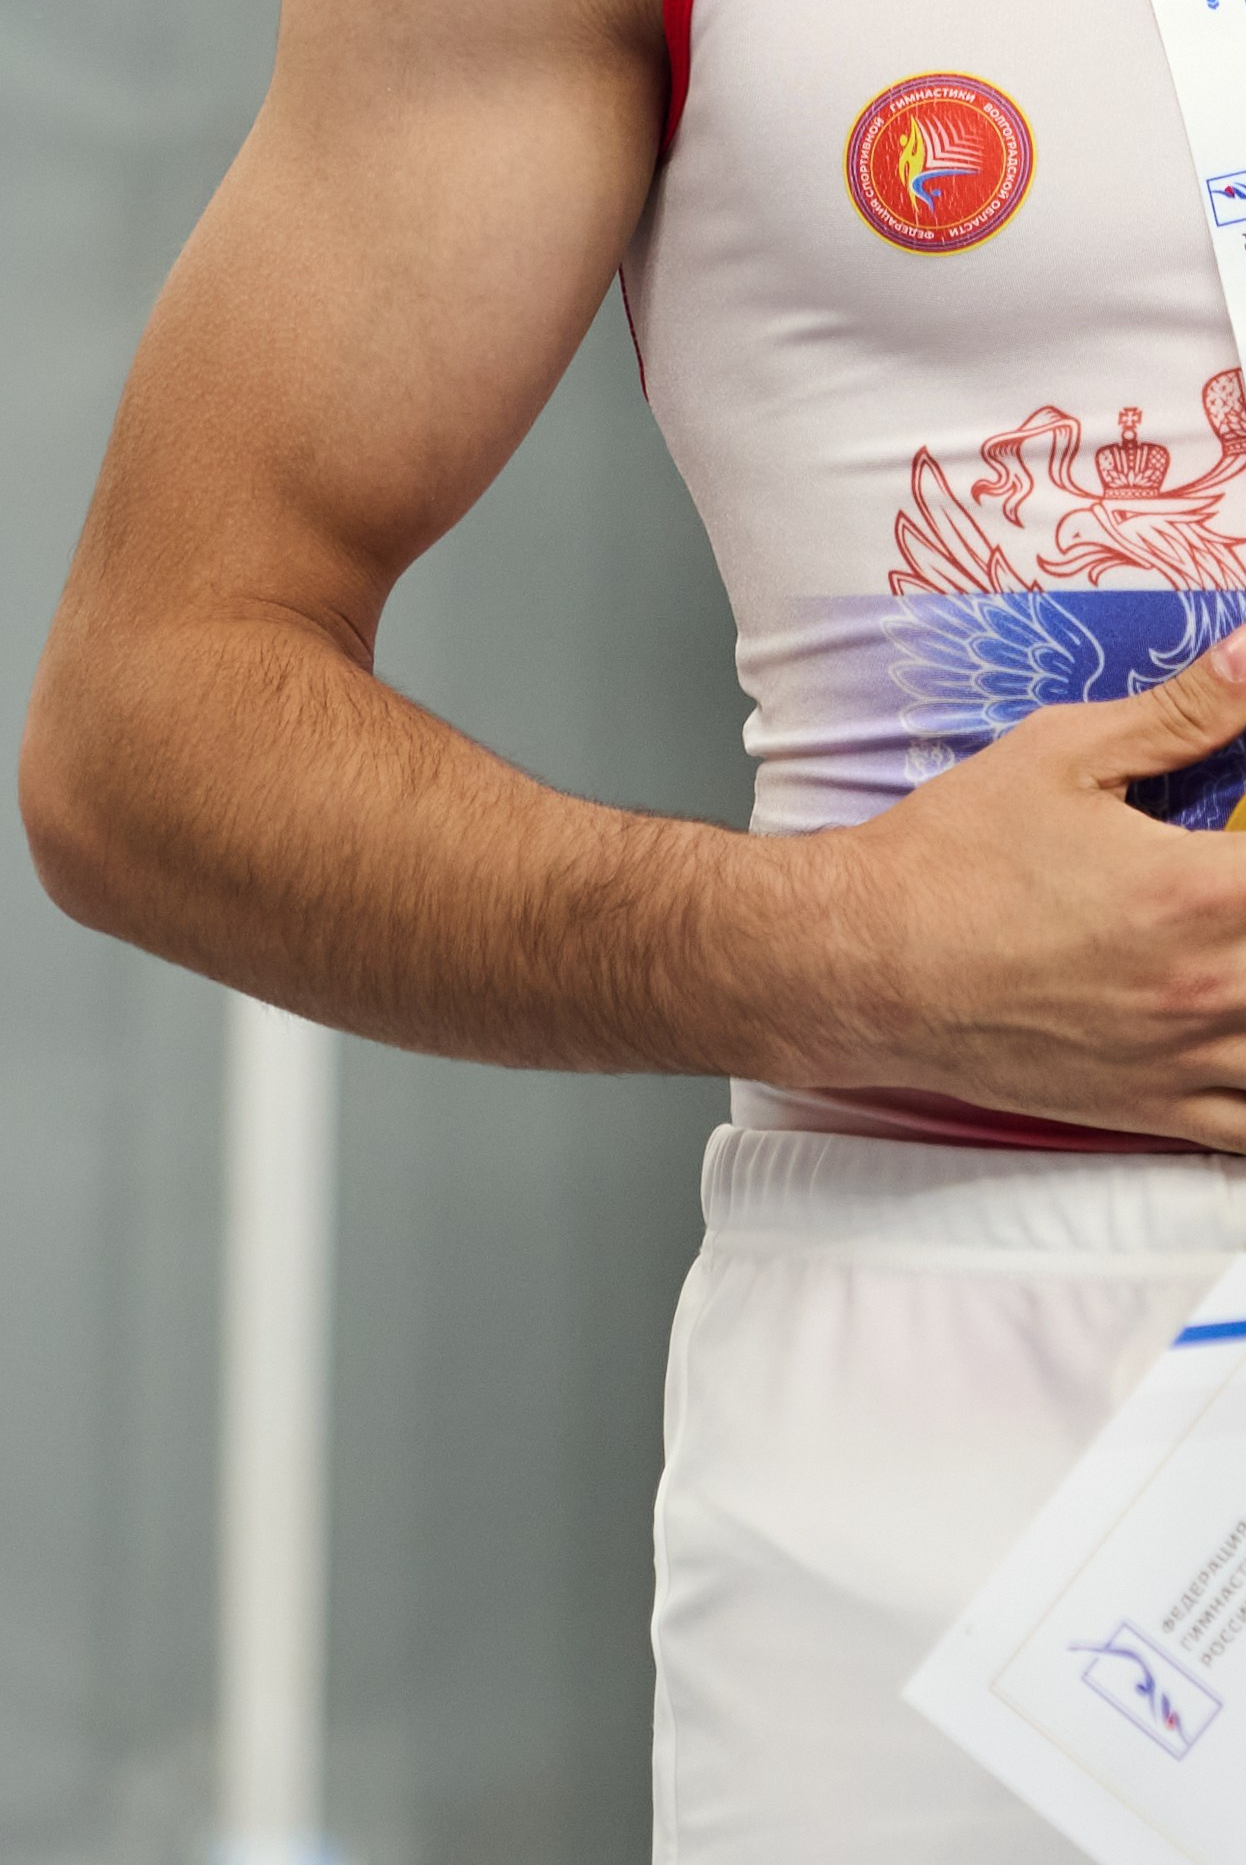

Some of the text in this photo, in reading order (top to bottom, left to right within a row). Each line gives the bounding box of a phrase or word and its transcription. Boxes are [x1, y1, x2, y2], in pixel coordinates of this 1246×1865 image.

[860, 88, 1018, 240] ФЕДЕРАЦИЯ СПОРТИВНОЙ ГИМНАСТИКИ ВОЛГОГРАДСКОЙ ОБЛАСТИ
